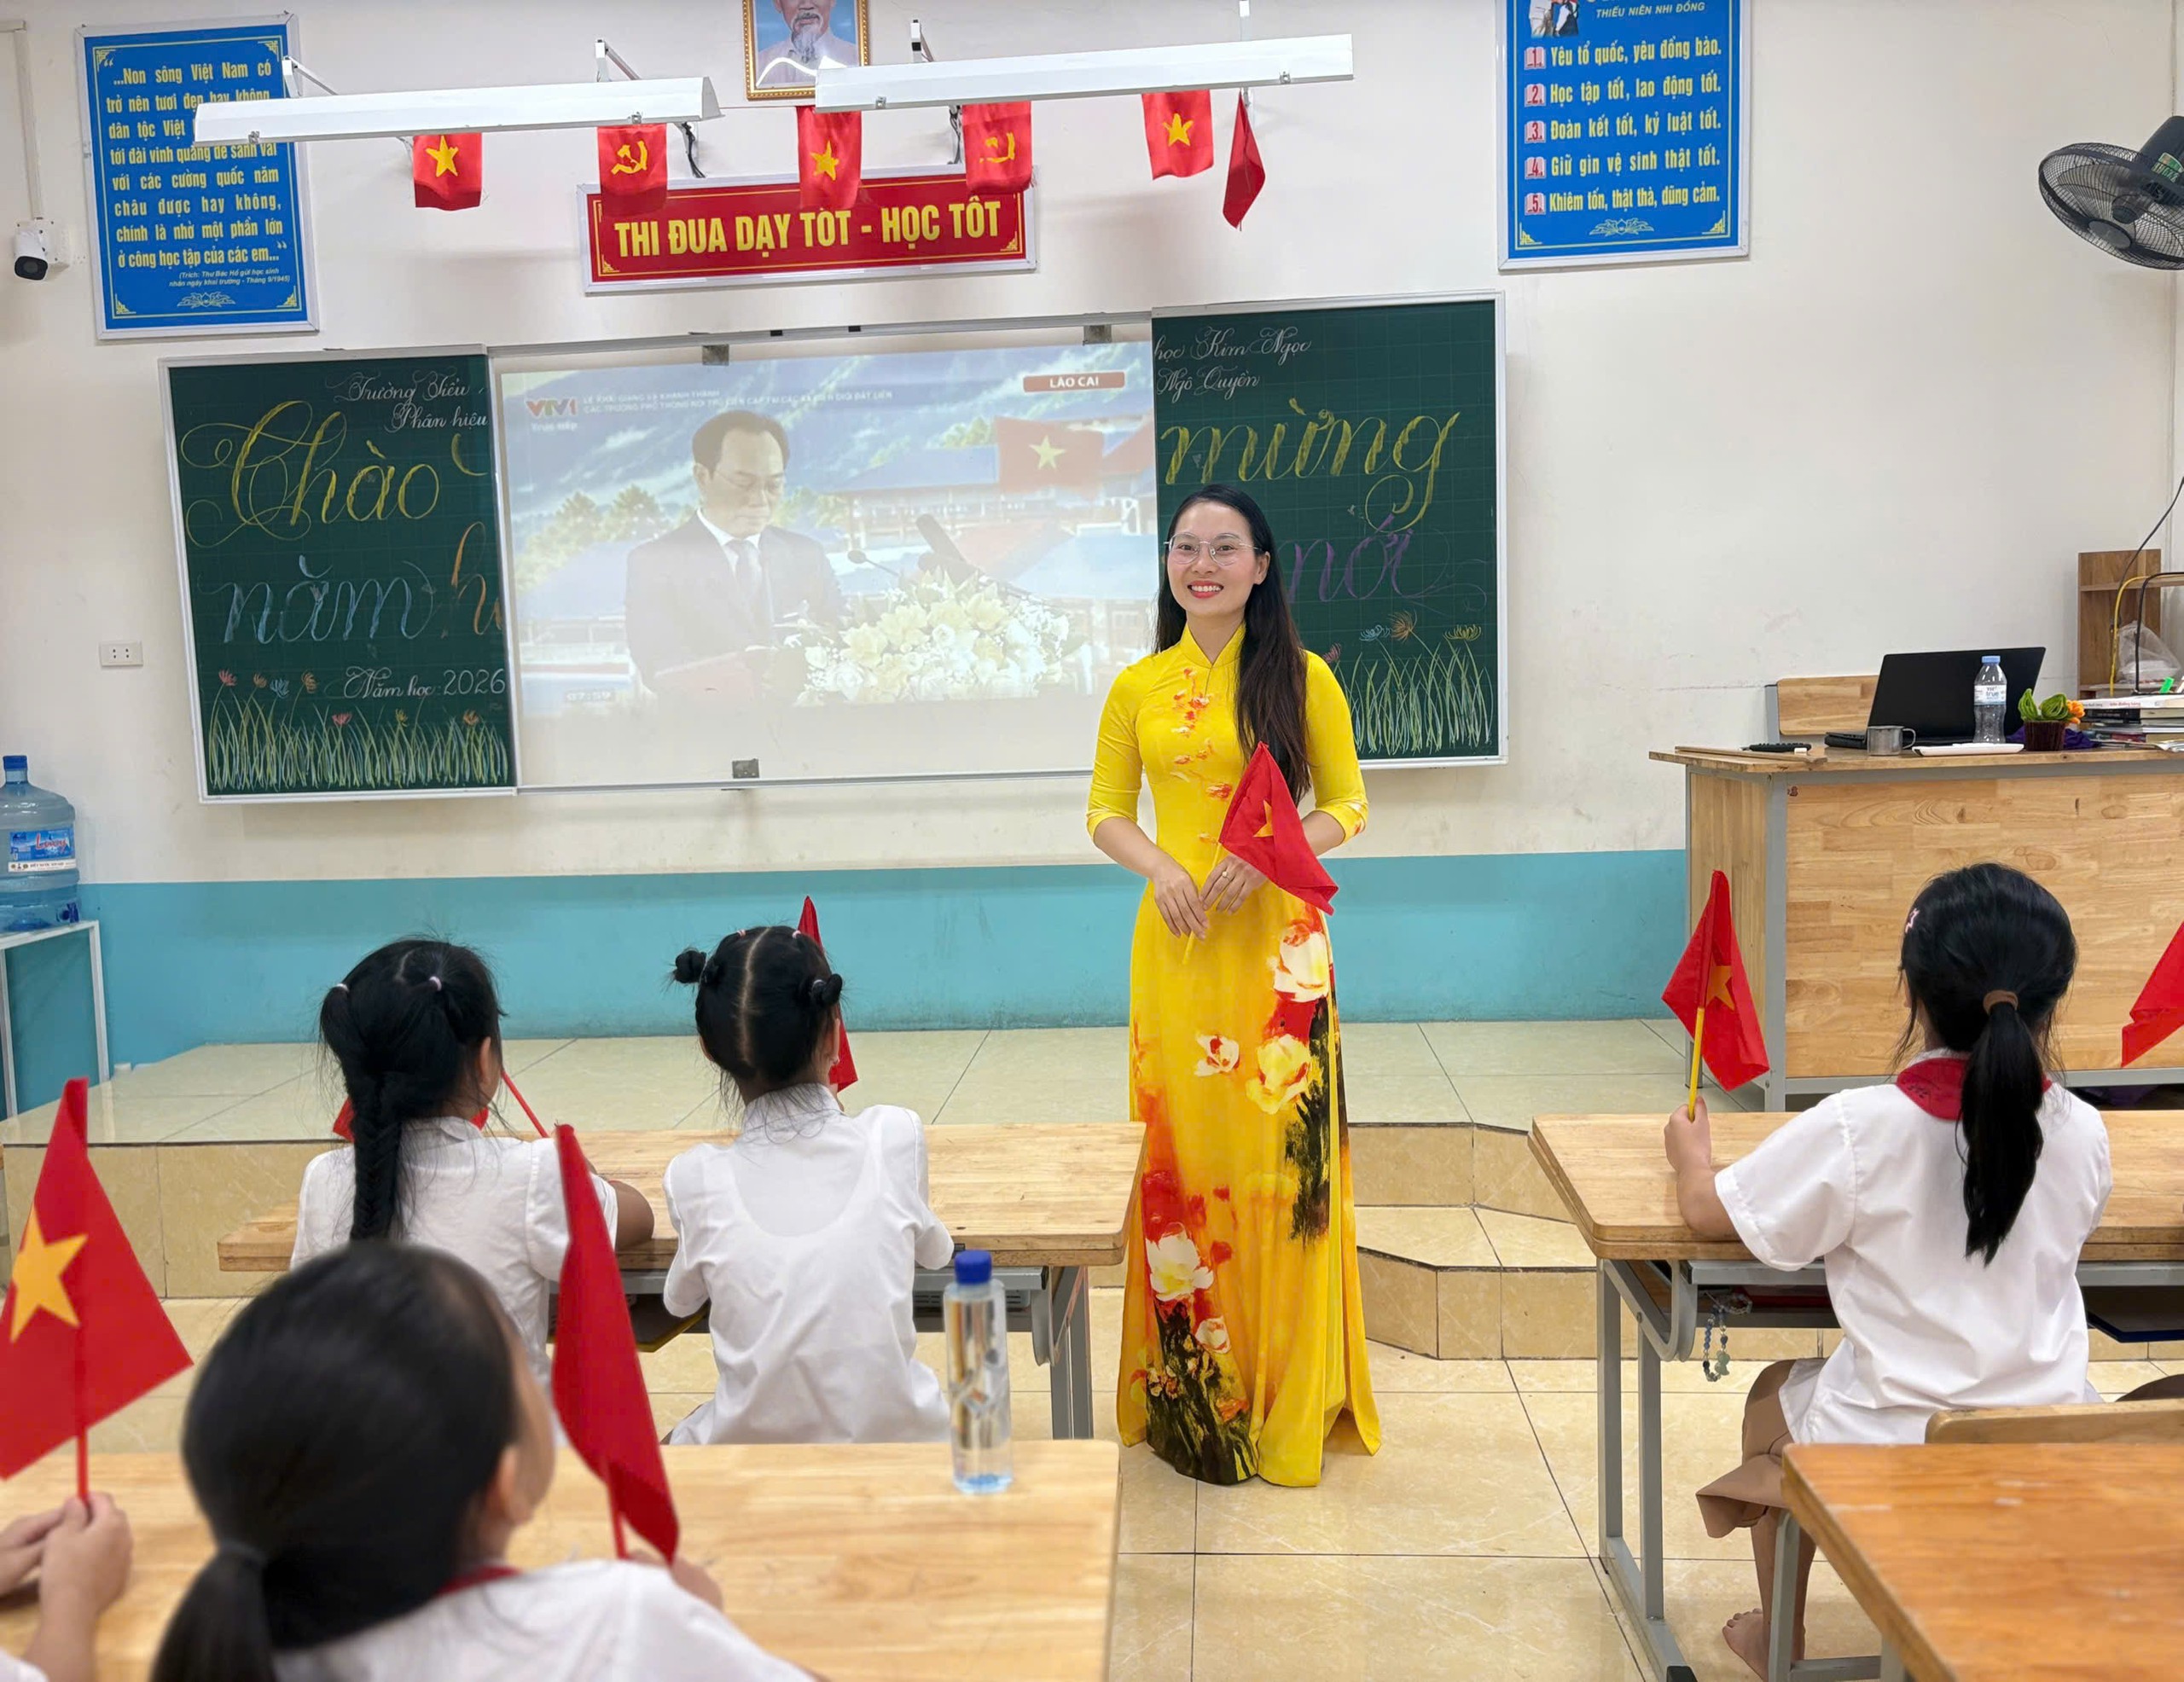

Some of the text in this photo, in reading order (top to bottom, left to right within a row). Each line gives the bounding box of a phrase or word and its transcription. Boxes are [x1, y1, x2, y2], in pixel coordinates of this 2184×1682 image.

[1628, 6, 1652, 17] NIÊN
[1655, 5, 1672, 14] NHI
[1550, 46, 1572, 67] Yêu
[1594, 39, 1629, 67] quốc,
[1633, 40, 1655, 64] yêu
[155, 65, 183, 84] sông
[191, 61, 213, 84] Việt
[222, 61, 248, 79] Nam
[258, 58, 271, 77] có
[107, 93, 123, 113] trở
[129, 95, 149, 113] nên
[156, 93, 177, 112] tươi
[1550, 83, 1573, 107] Học
[1581, 80, 1600, 106] tập
[1607, 75, 1630, 102] tốt,
[1635, 78, 1655, 97] lao
[1663, 75, 1693, 100] động
[1700, 69, 1722, 93] tốt.
[108, 122, 130, 139] dân
[137, 120, 155, 142] tộc
[163, 119, 185, 140] Việt
[1550, 119, 1581, 141] Đoàn
[1589, 113, 1609, 138] kết
[1616, 112, 1637, 137] tốt,
[1645, 111, 1659, 136] kỷ
[1667, 111, 1693, 136] luật
[1699, 106, 1722, 130] tốt.
[110, 147, 125, 165] tới
[129, 147, 147, 165] đài
[149, 145, 173, 163] vinh
[1551, 154, 1572, 177] Giữ
[1579, 154, 1600, 177] gìn
[1607, 152, 1623, 177] vệ
[1629, 150, 1657, 172] sinh
[1664, 147, 1691, 172] thật
[1698, 142, 1721, 167] tốt.
[112, 174, 130, 191] với
[140, 171, 161, 189] các
[217, 165, 244, 188] quốc
[254, 167, 279, 184] năm
[114, 192, 282, 218] châu được hay không,
[1549, 191, 1583, 213] Khiêm
[1588, 186, 1608, 212] tốn,
[1612, 190, 1633, 212] thật
[1636, 187, 1658, 208] thà,
[1662, 183, 1688, 207] dũng
[1693, 180, 1721, 204] cảm.
[116, 216, 283, 242] chính là nhờ một phần lớn
[613, 220, 660, 258] THI
[668, 217, 728, 255] ĐUA
[735, 213, 792, 258] DẠY
[880, 205, 940, 251] HỌC
[128, 252, 156, 270] công
[160, 250, 180, 270] học
[183, 248, 200, 269] tập
[204, 246, 224, 264] của
[227, 246, 247, 264] các
[1153, 326, 1312, 366] học Kim Ngọc
[325, 367, 470, 409] Trường Tiểu
[1077, 375, 1099, 387] CAI
[1156, 365, 1261, 403] Ngô Quyền
[385, 402, 490, 433] Phân hiệu
[526, 397, 578, 418] VTV1
[180, 399, 440, 548] Chào
[1160, 397, 1461, 532] mừng
[197, 554, 437, 644] năm
[328, 666, 404, 699] Năm
[443, 668, 506, 696] 2026
